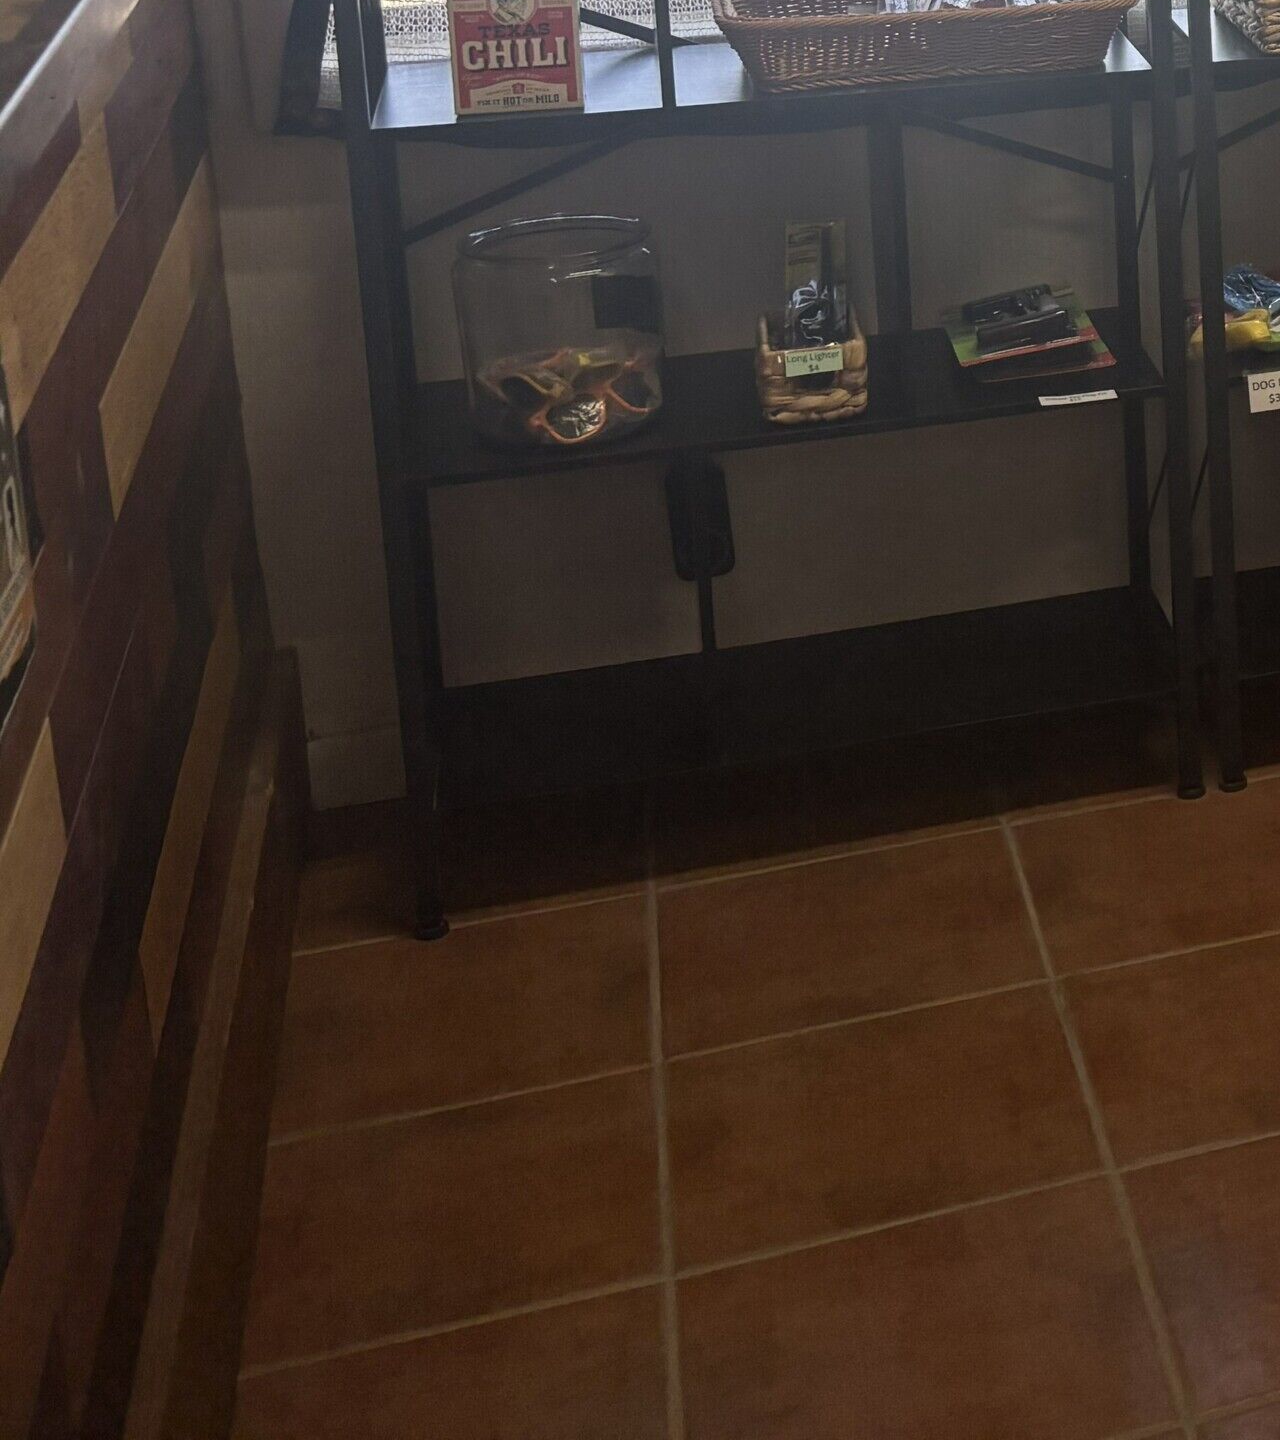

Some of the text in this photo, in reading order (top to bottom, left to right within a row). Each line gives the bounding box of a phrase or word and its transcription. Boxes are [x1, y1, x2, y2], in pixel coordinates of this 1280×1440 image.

[478, 23, 551, 38] TEXAS
[462, 36, 568, 71] CHILI
[503, 96, 521, 106] HOT
[1252, 378, 1277, 392] DOG
